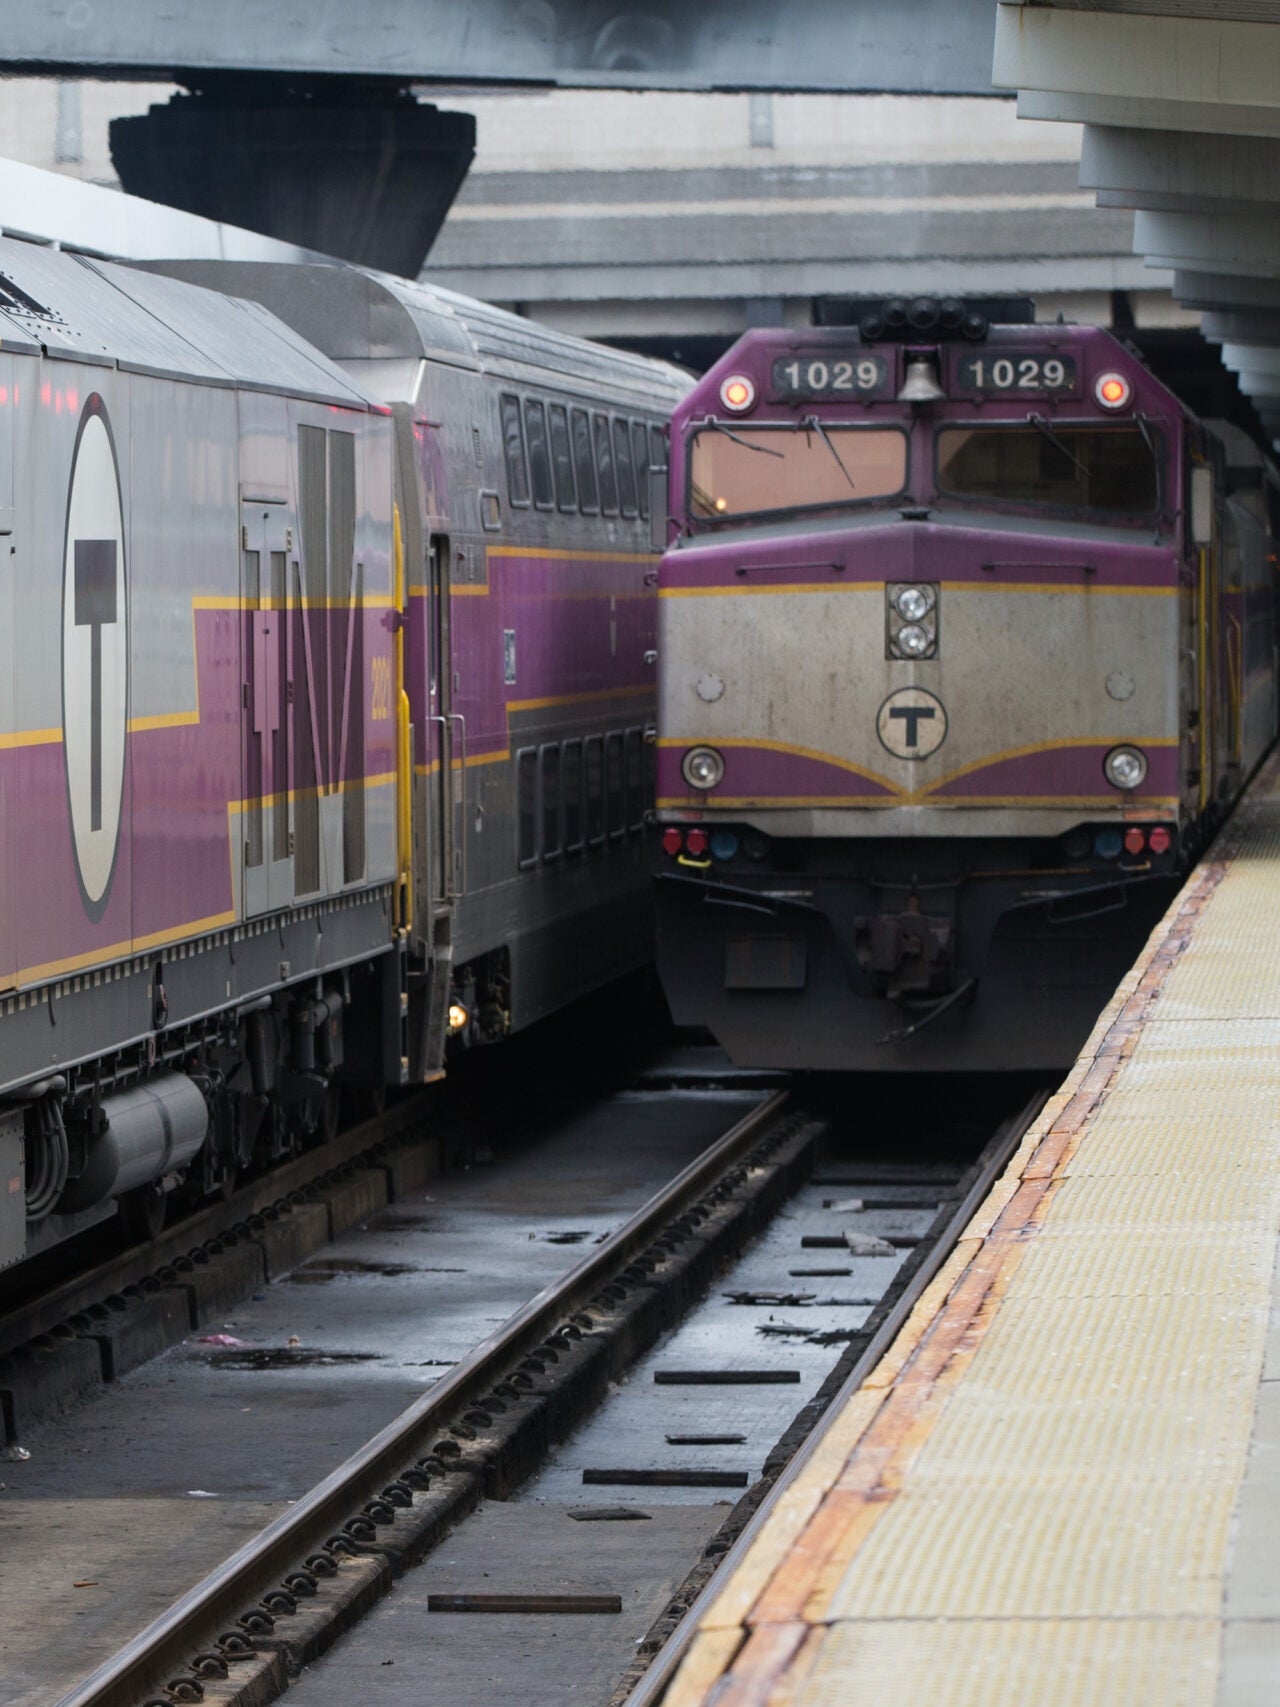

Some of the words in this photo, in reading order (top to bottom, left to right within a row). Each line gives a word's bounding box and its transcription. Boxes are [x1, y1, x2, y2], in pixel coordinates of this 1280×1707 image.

[784, 360, 879, 390] 1029
[969, 359, 1066, 388] 1029
[74, 539, 118, 833] T
[371, 656, 393, 721] 2021
[889, 706, 936, 748] T
